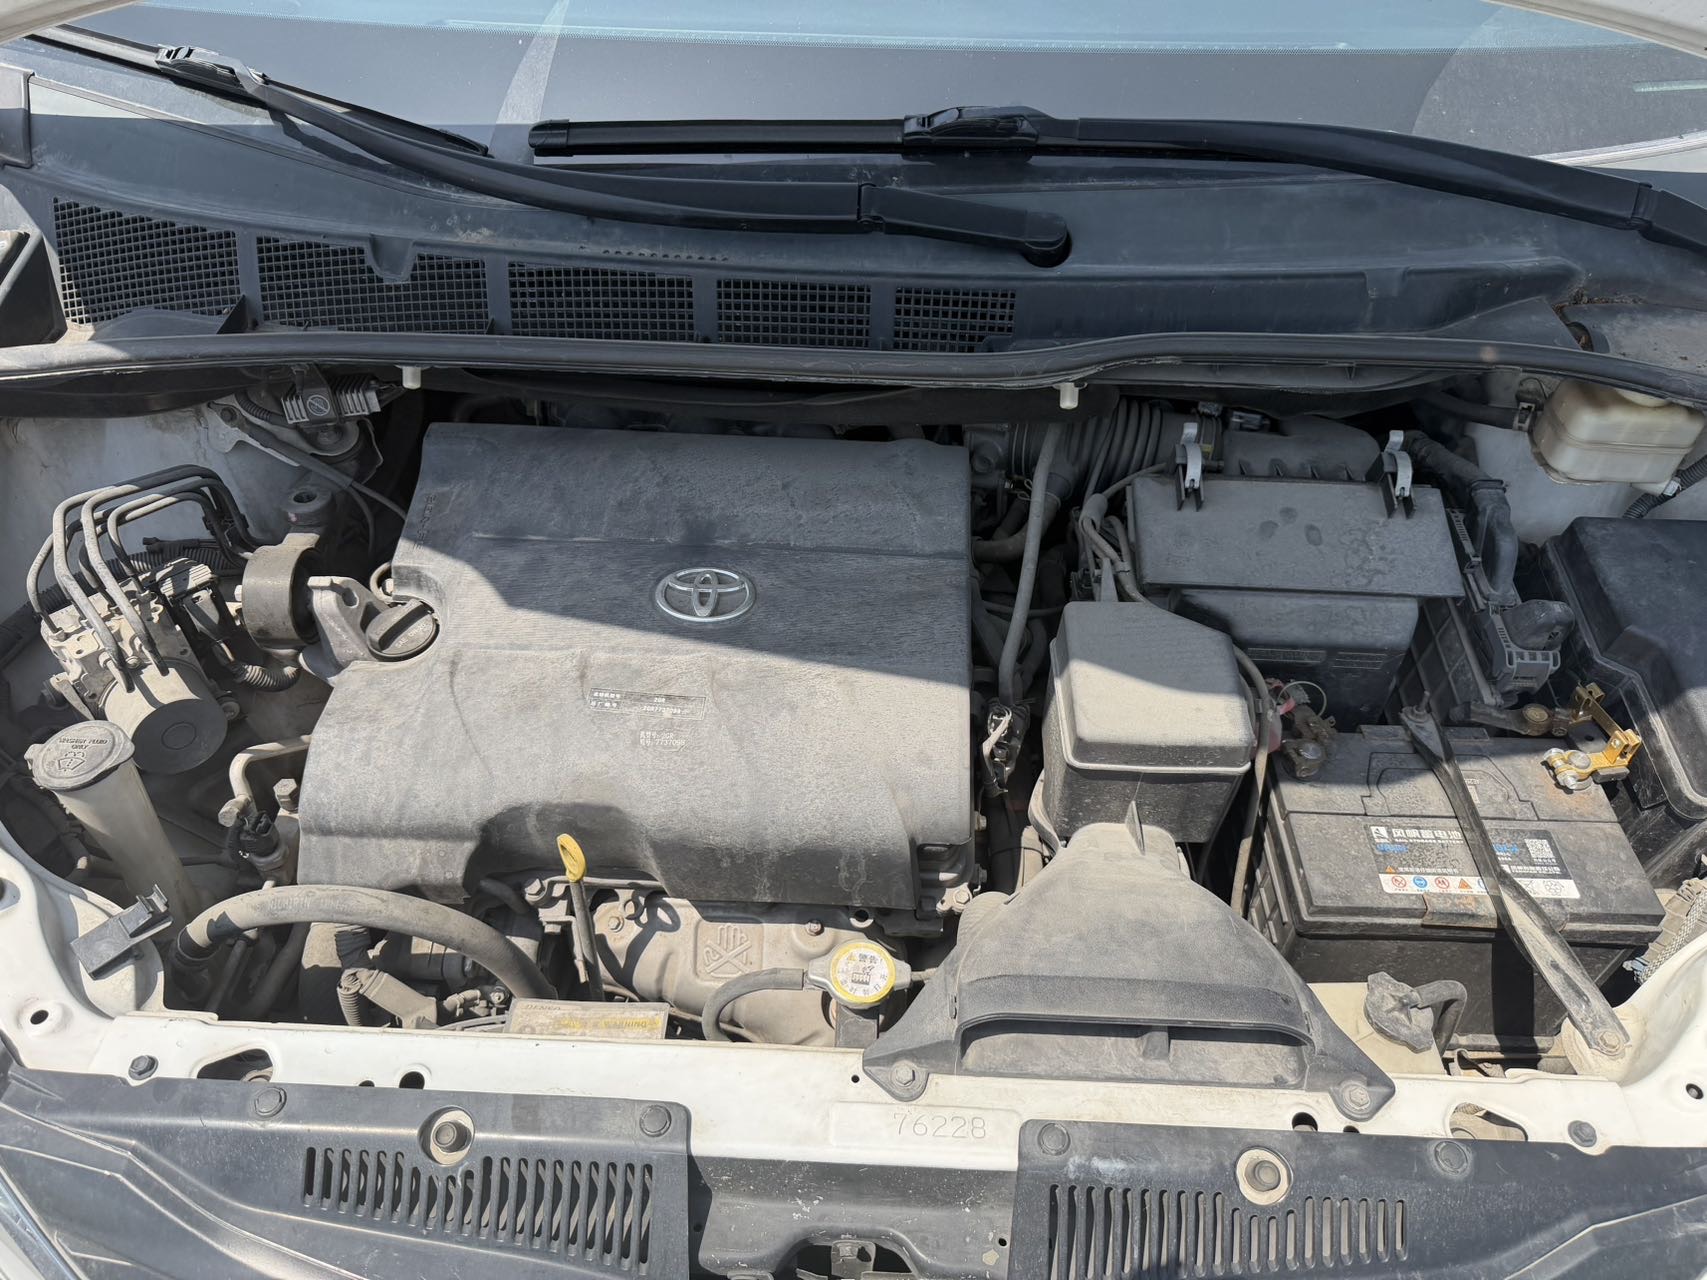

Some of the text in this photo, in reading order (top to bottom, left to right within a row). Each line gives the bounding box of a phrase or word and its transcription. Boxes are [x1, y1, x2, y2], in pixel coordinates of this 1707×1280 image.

[1391, 828, 1462, 841] 风帆蓄电池
[893, 1112, 986, 1139] 76228
